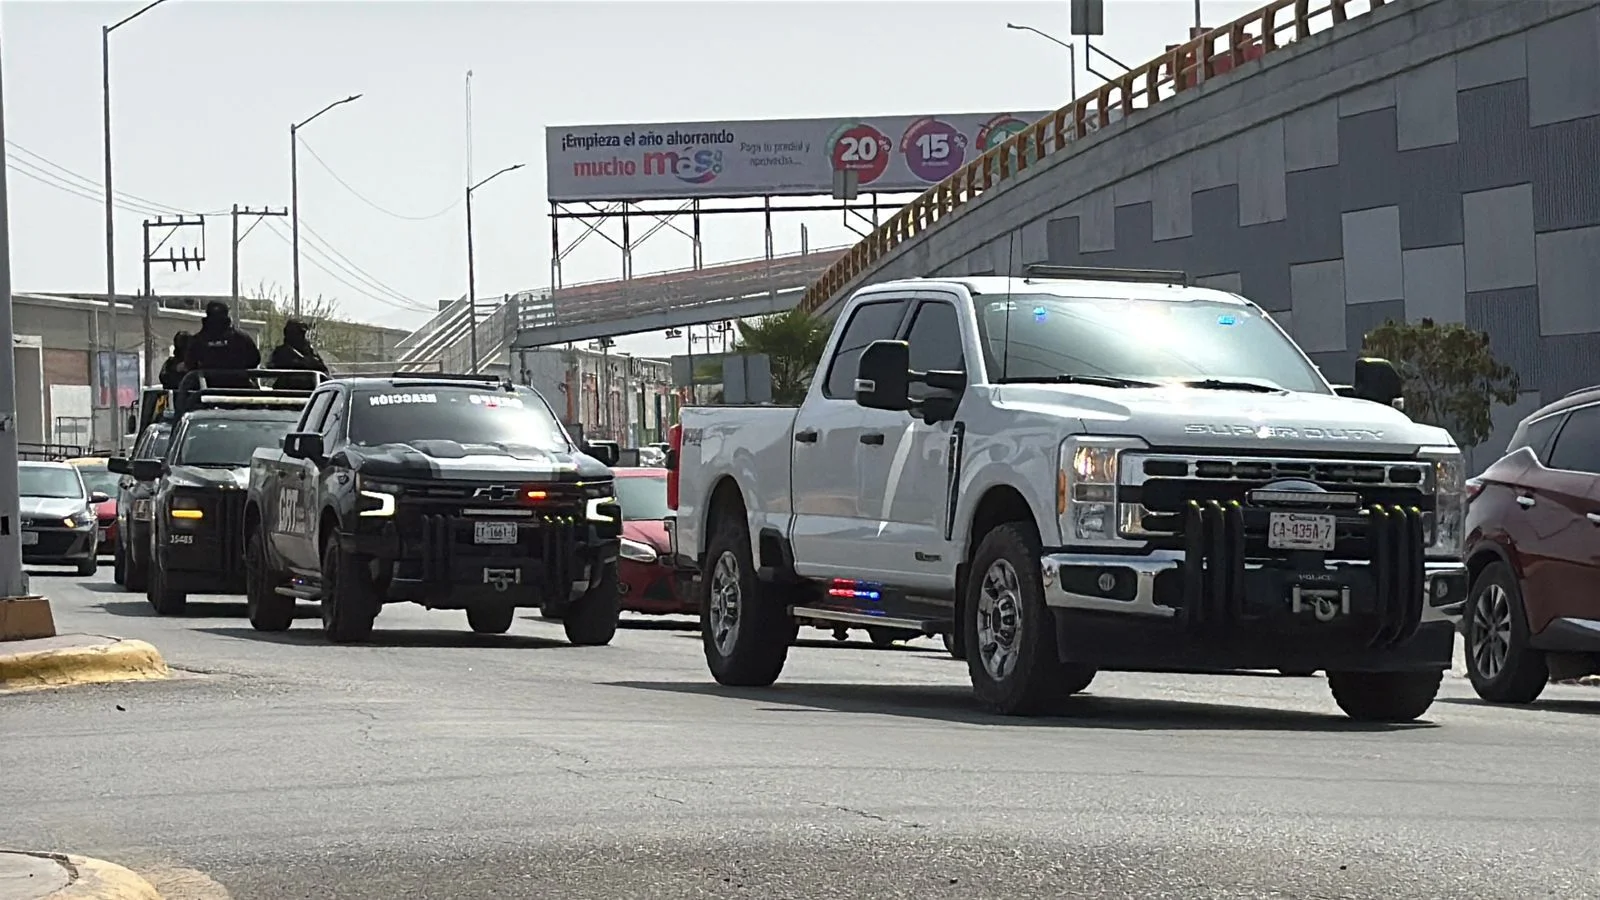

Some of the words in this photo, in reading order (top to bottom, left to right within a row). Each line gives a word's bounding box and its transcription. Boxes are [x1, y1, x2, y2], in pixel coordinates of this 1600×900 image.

[562, 132, 620, 151] ¡Empieza
[624, 131, 636, 146] el
[638, 131, 664, 146] año
[667, 129, 735, 145] ahorrando
[573, 156, 637, 177] mucho
[1184, 423, 1300, 439] SUPER
[1303, 427, 1384, 440] DUTY
